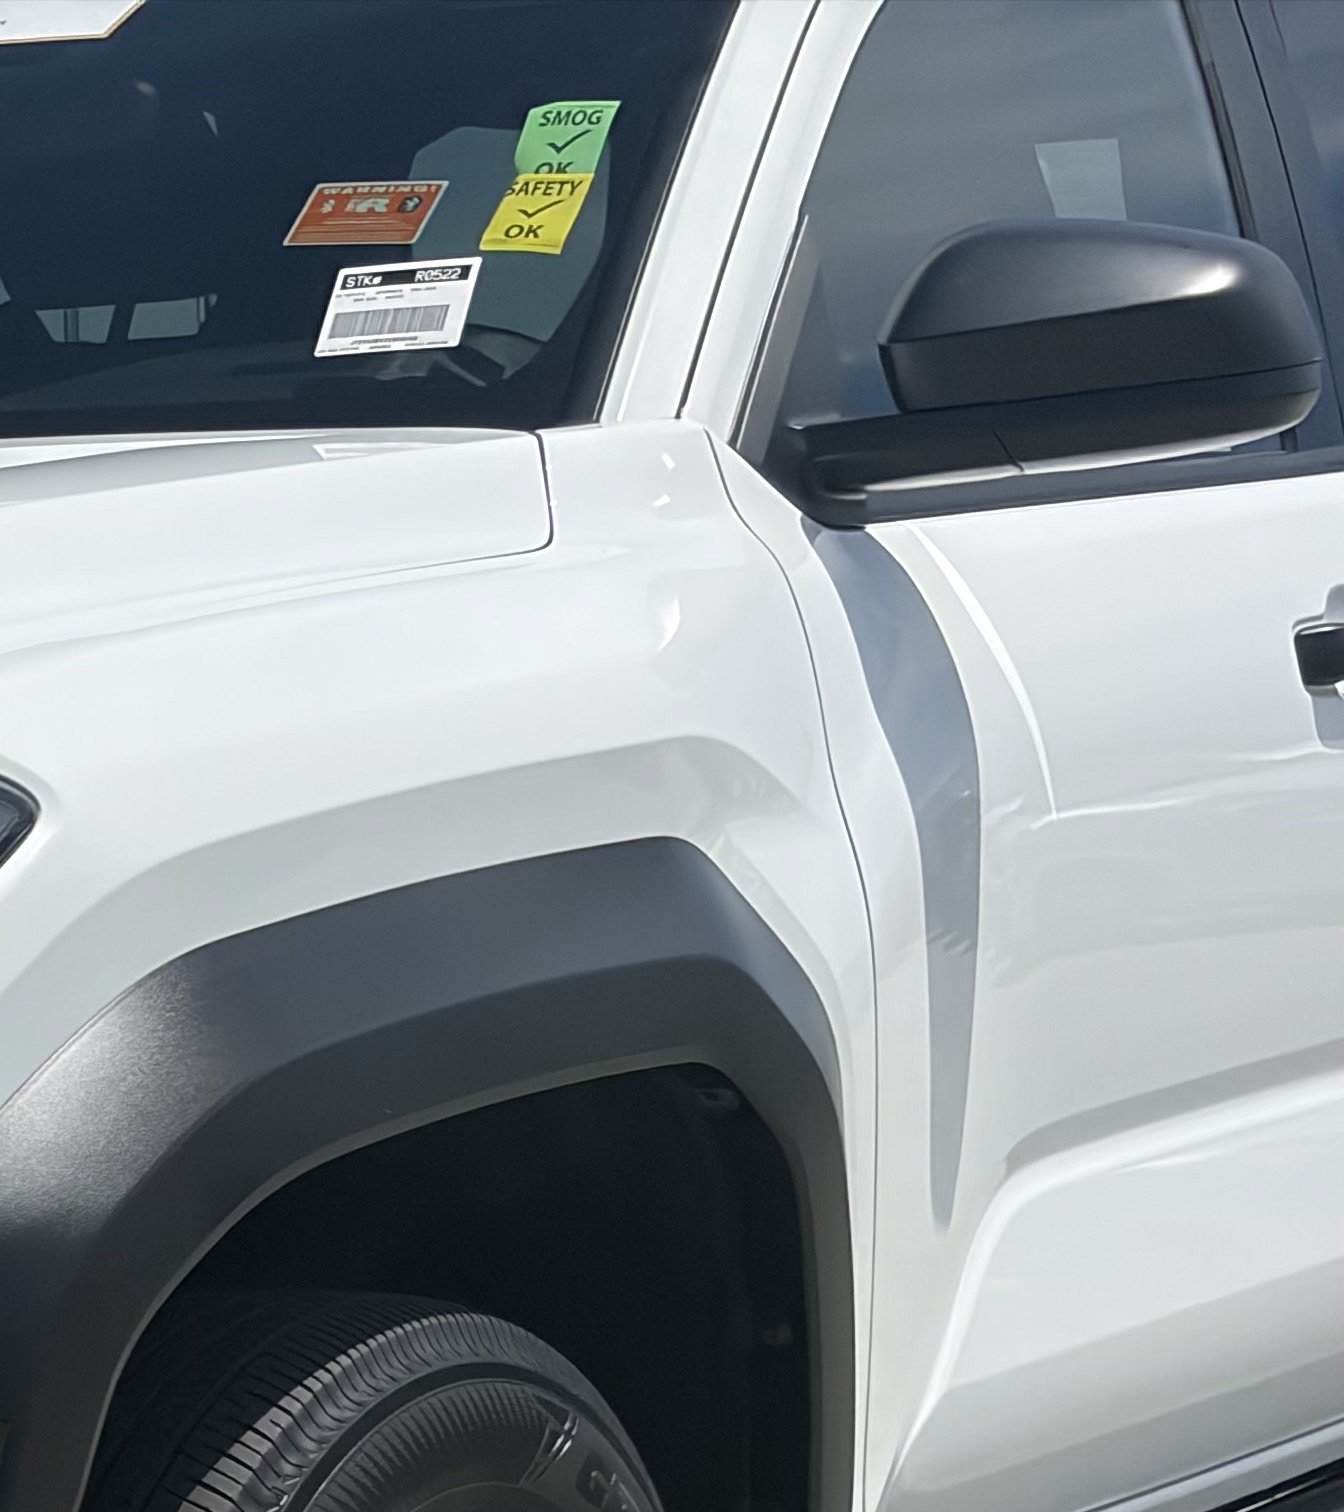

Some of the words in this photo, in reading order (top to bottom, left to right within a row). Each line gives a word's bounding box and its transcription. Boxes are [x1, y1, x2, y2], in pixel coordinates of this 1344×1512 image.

[537, 109, 604, 127] SMOG
[533, 161, 575, 174] OK
[505, 179, 584, 196] SAFETY
[503, 224, 545, 239] OK
